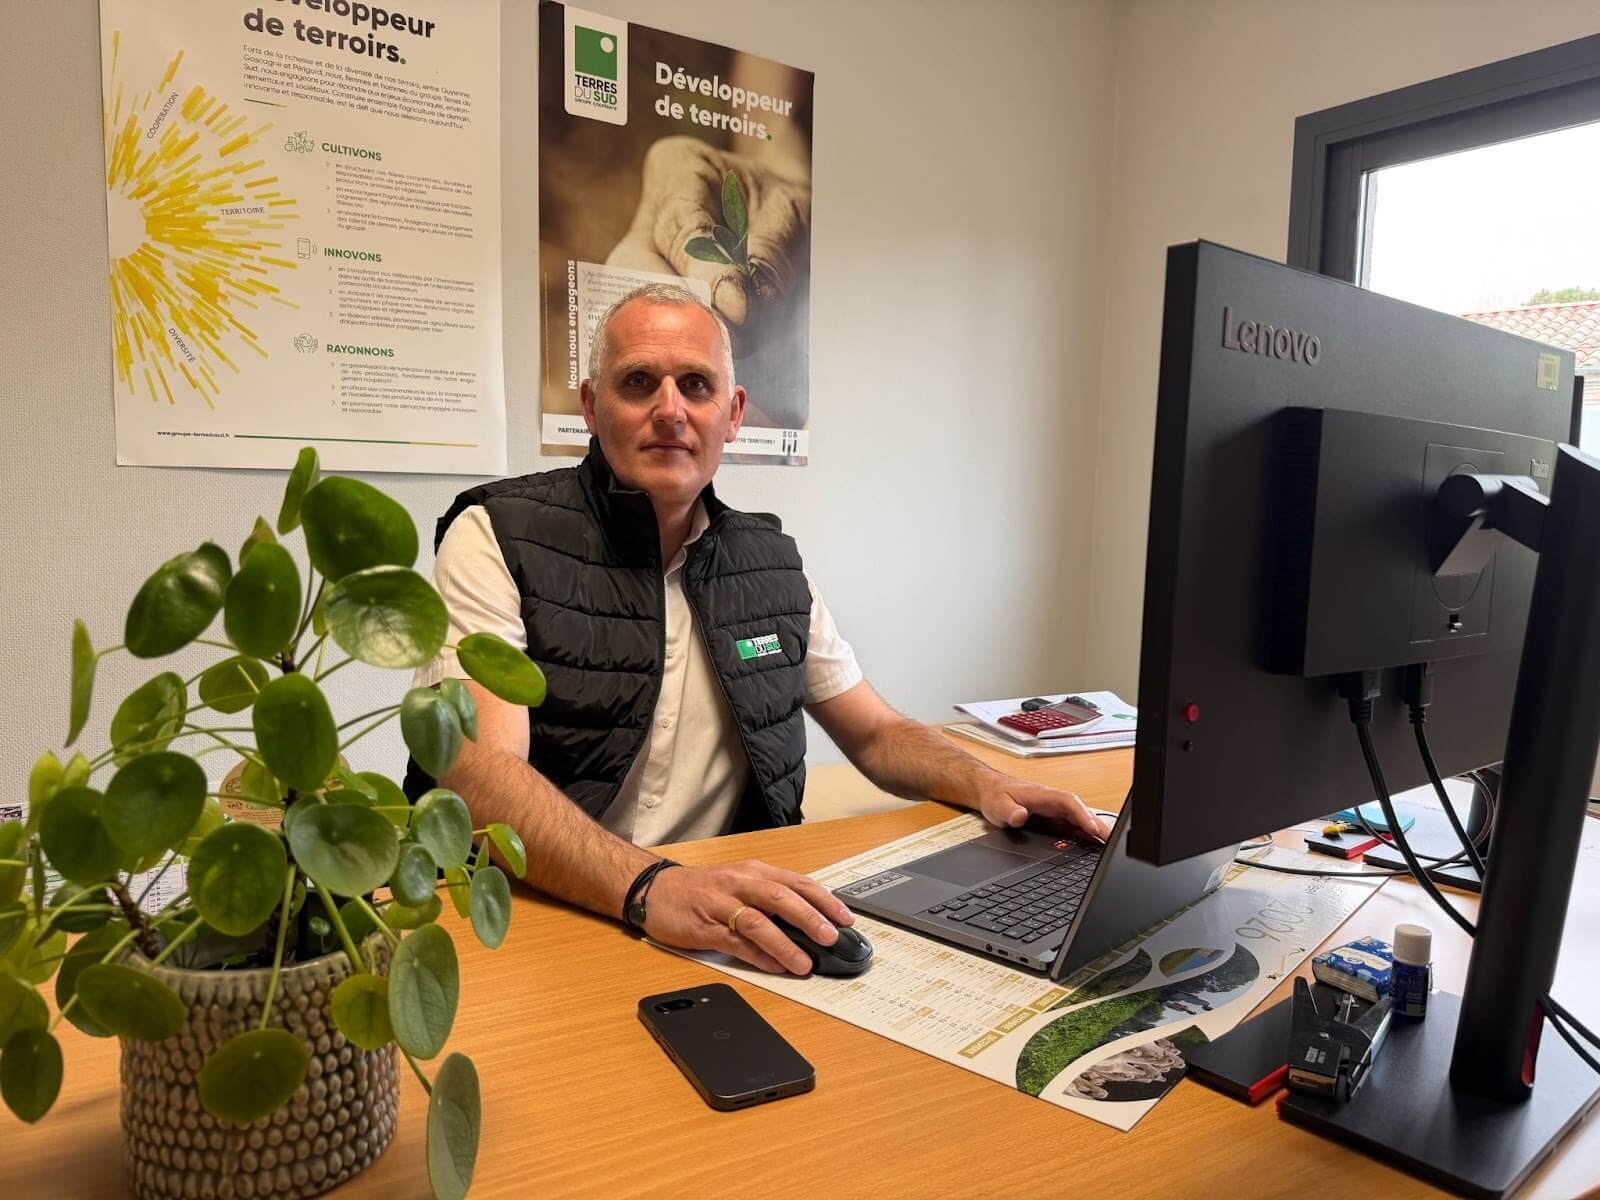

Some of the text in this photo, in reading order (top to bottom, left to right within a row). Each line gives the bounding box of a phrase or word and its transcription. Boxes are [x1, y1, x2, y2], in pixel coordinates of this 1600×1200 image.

[244, 8, 406, 64] de terroirs.
[575, 74, 617, 94] TERRES
[575, 86, 617, 105] DU SUD
[655, 62, 793, 117] Développeur
[654, 95, 772, 141] de terroirs.
[322, 142, 382, 161] CULTIVONS
[221, 206, 264, 216] TERRITOIRE
[324, 248, 382, 262] INNOVONS
[568, 260, 577, 326] engageons
[168, 328, 196, 362] DIVERSITÉ
[326, 344, 394, 358] RAYONNONS
[1222, 306, 1321, 366] Lenovo
[568, 360, 577, 390] Nous
